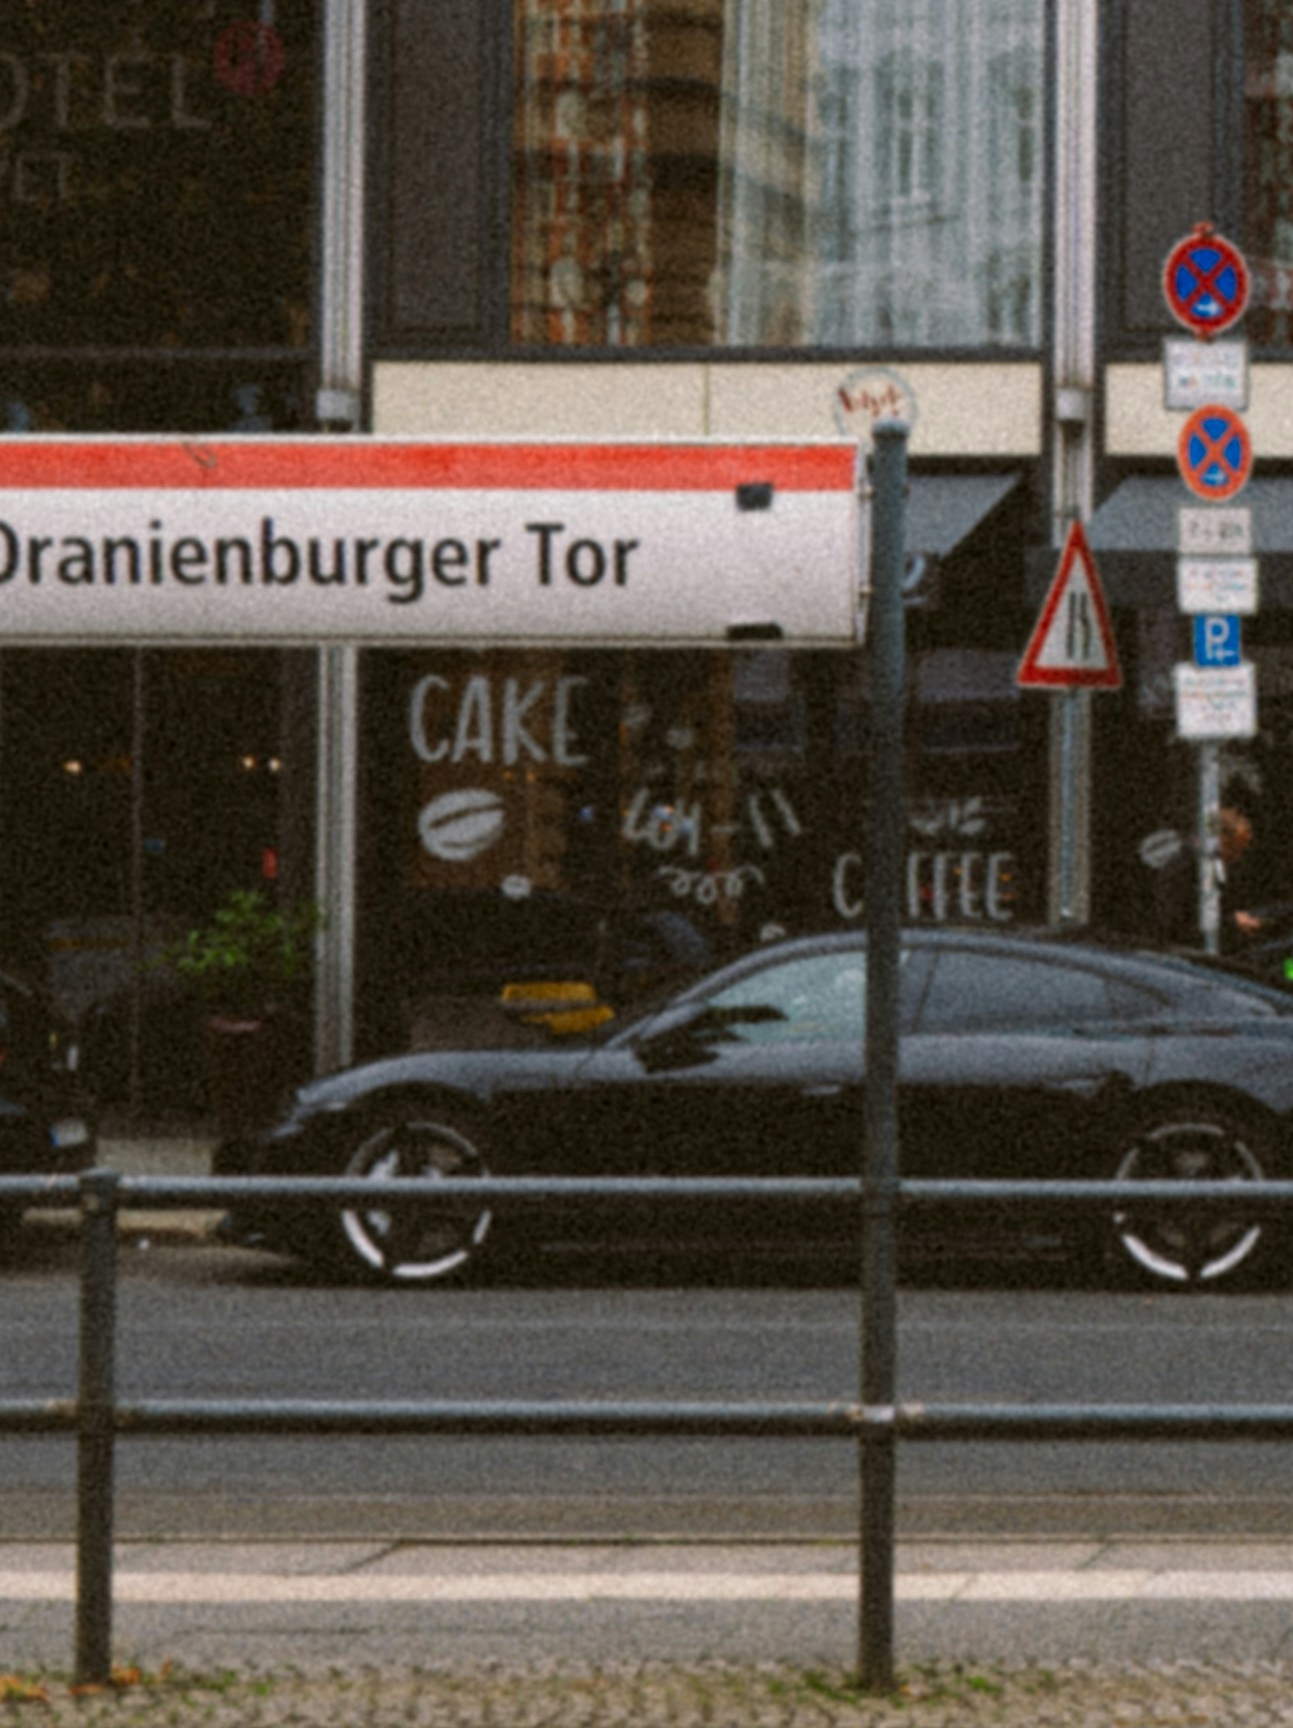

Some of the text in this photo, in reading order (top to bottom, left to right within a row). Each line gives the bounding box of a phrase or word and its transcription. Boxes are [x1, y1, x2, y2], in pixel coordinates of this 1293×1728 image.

[524, 522, 640, 586] Tor
[409, 674, 591, 766] CAKE
[832, 850, 1015, 921] CFFEE
